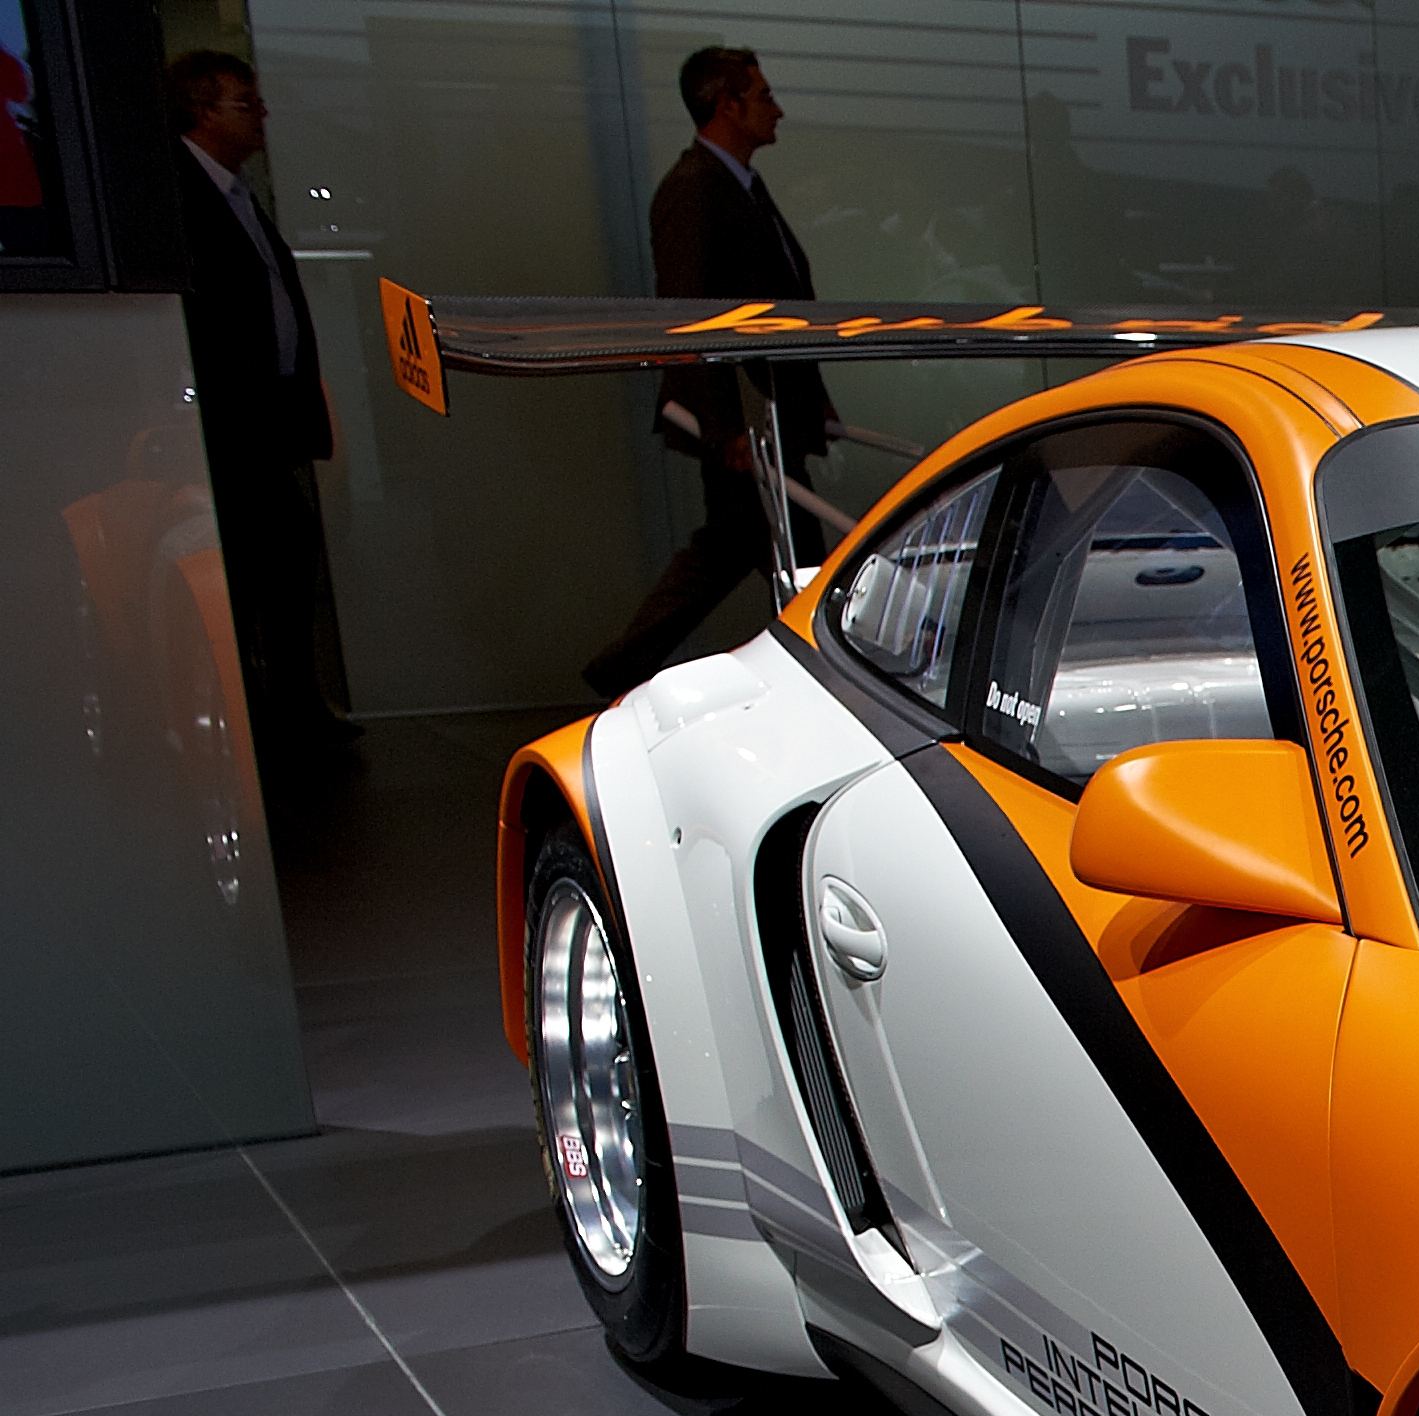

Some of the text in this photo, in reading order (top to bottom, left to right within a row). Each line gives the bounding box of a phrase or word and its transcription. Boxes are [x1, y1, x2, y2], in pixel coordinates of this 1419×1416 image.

[986, 680, 1042, 726] Do not open
[1290, 551, 1369, 859] www.porsche.com
[561, 1136, 587, 1177] BBS
